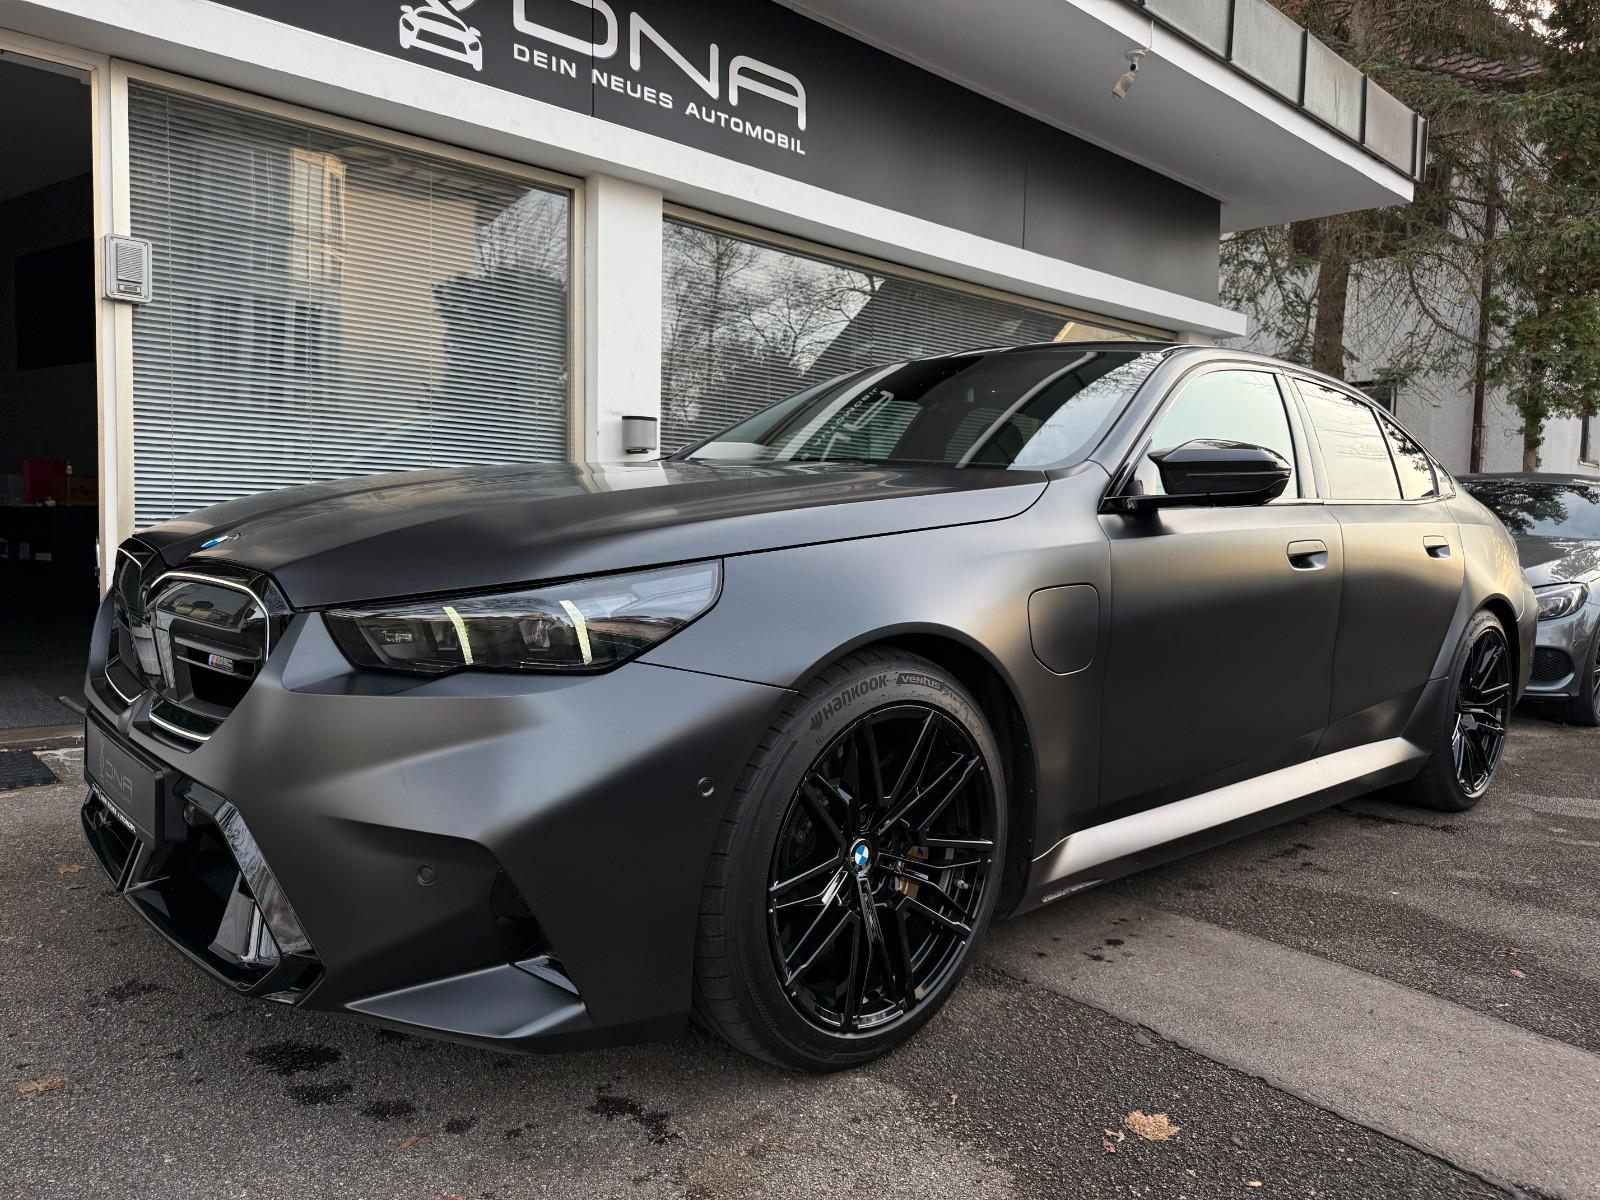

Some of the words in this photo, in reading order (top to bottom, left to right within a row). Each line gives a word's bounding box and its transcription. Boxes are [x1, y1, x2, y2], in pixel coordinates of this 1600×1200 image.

[512, 0, 807, 131] DNA
[513, 43, 577, 79] DEIN
[591, 68, 674, 109] NEUES
[684, 101, 807, 155] AUTOMOBIL
